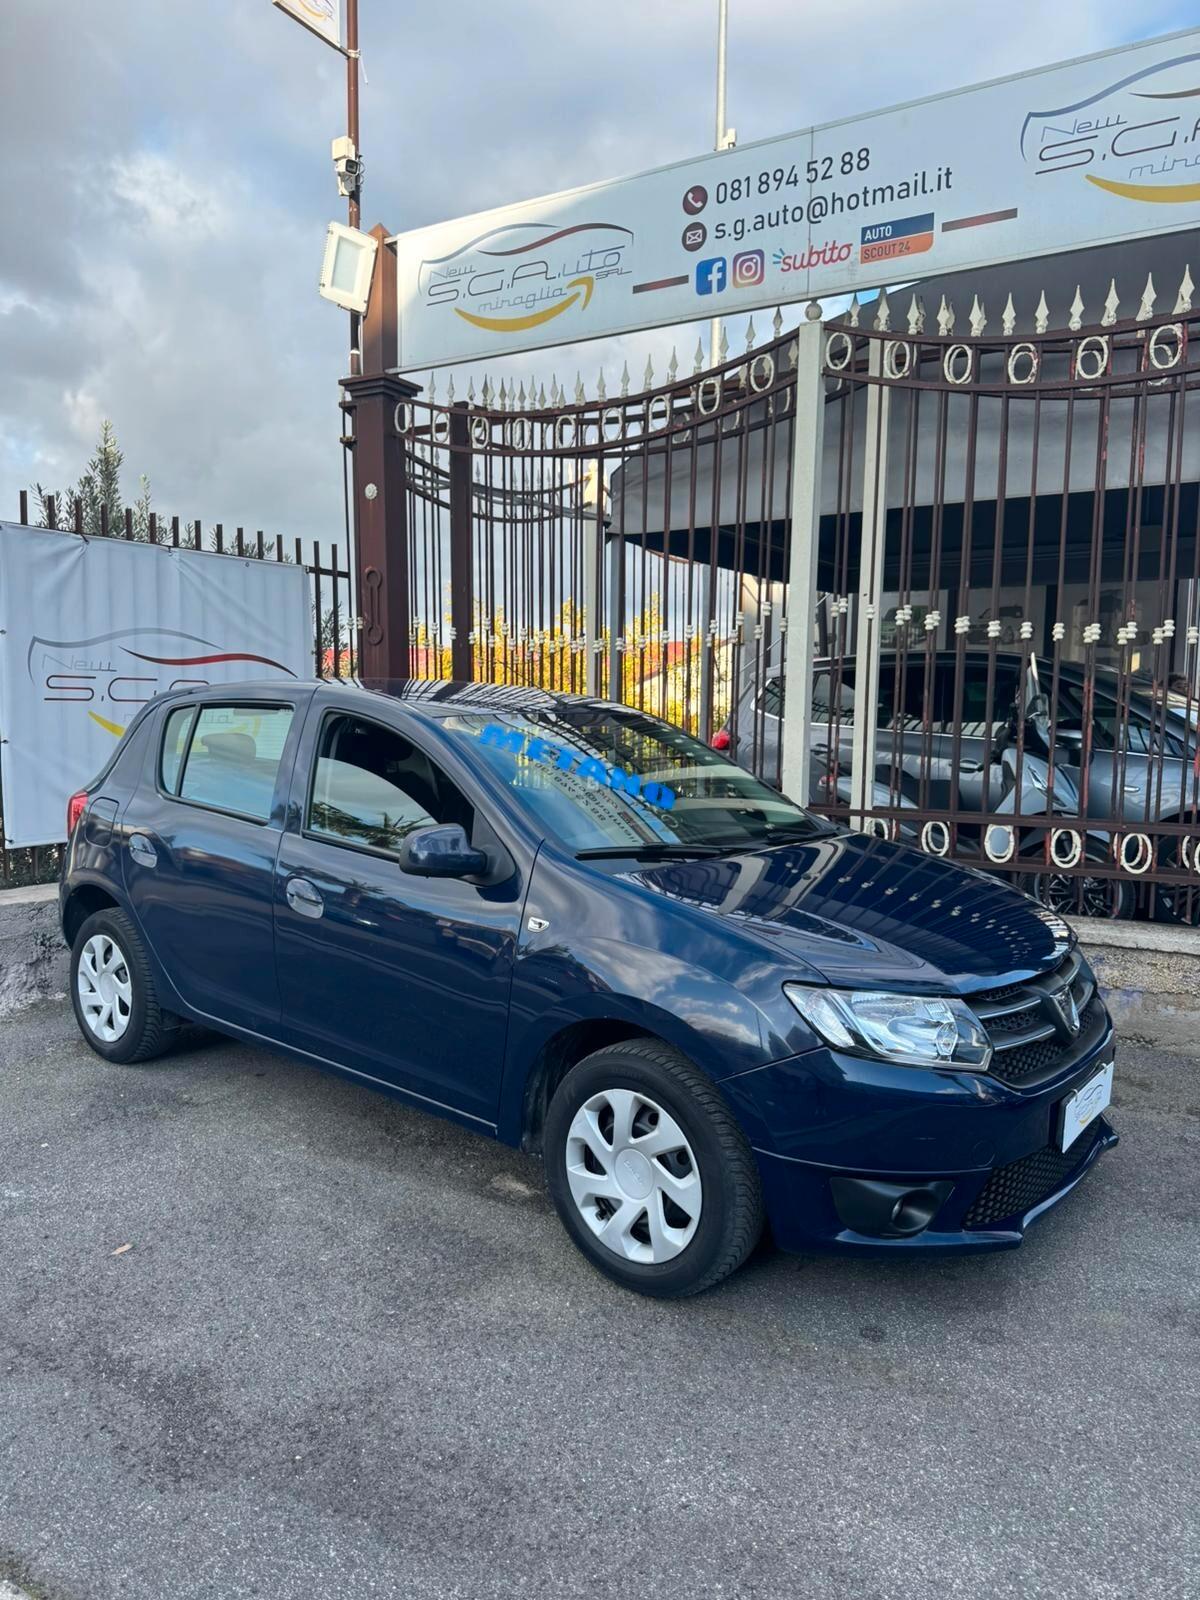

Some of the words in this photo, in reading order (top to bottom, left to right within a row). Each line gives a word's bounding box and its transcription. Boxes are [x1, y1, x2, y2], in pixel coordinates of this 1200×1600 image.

[715, 174, 751, 204] 081
[757, 164, 799, 195] 894
[806, 156, 834, 184] 52
[840, 147, 870, 175] 88
[714, 167, 953, 241] s.g.auto@hotmail.it
[864, 225, 892, 242] AUTO
[864, 244, 896, 260] SCOUT
[898, 241, 911, 254] 24
[780, 240, 853, 273] subito
[479, 722, 676, 811] METANO
